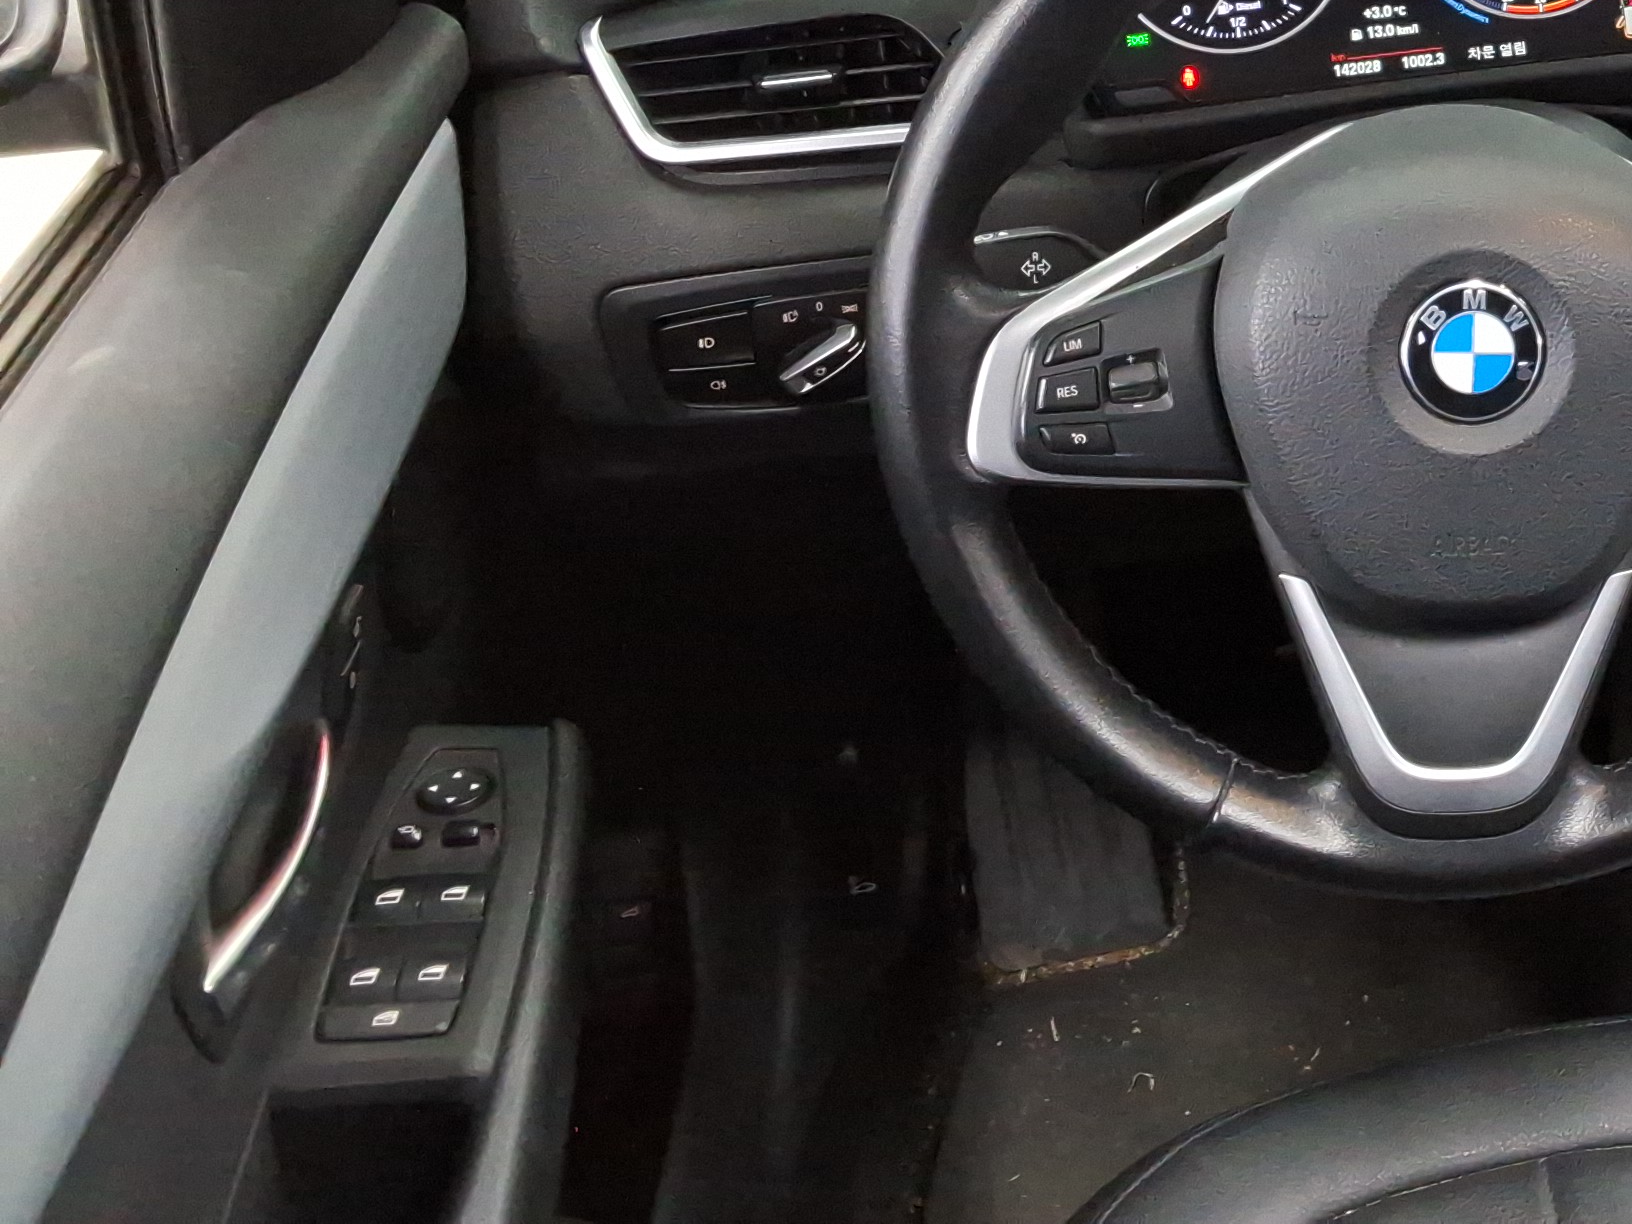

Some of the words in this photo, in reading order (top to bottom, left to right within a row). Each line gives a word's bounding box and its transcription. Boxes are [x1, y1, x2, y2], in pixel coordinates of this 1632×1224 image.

[1182, 5, 1192, 16] 0
[1363, 5, 1392, 19] +3.0
[1229, 16, 1247, 27] 1/2
[1367, 25, 1395, 40] 13.0
[1467, 45, 1496, 61] 차문
[1500, 41, 1526, 58] 열림
[1333, 60, 1382, 77] 142028
[1402, 52, 1445, 70] 1002.3
[1420, 288, 1530, 332] BMW
[1063, 338, 1083, 352] LIM
[1056, 384, 1079, 400] RES
